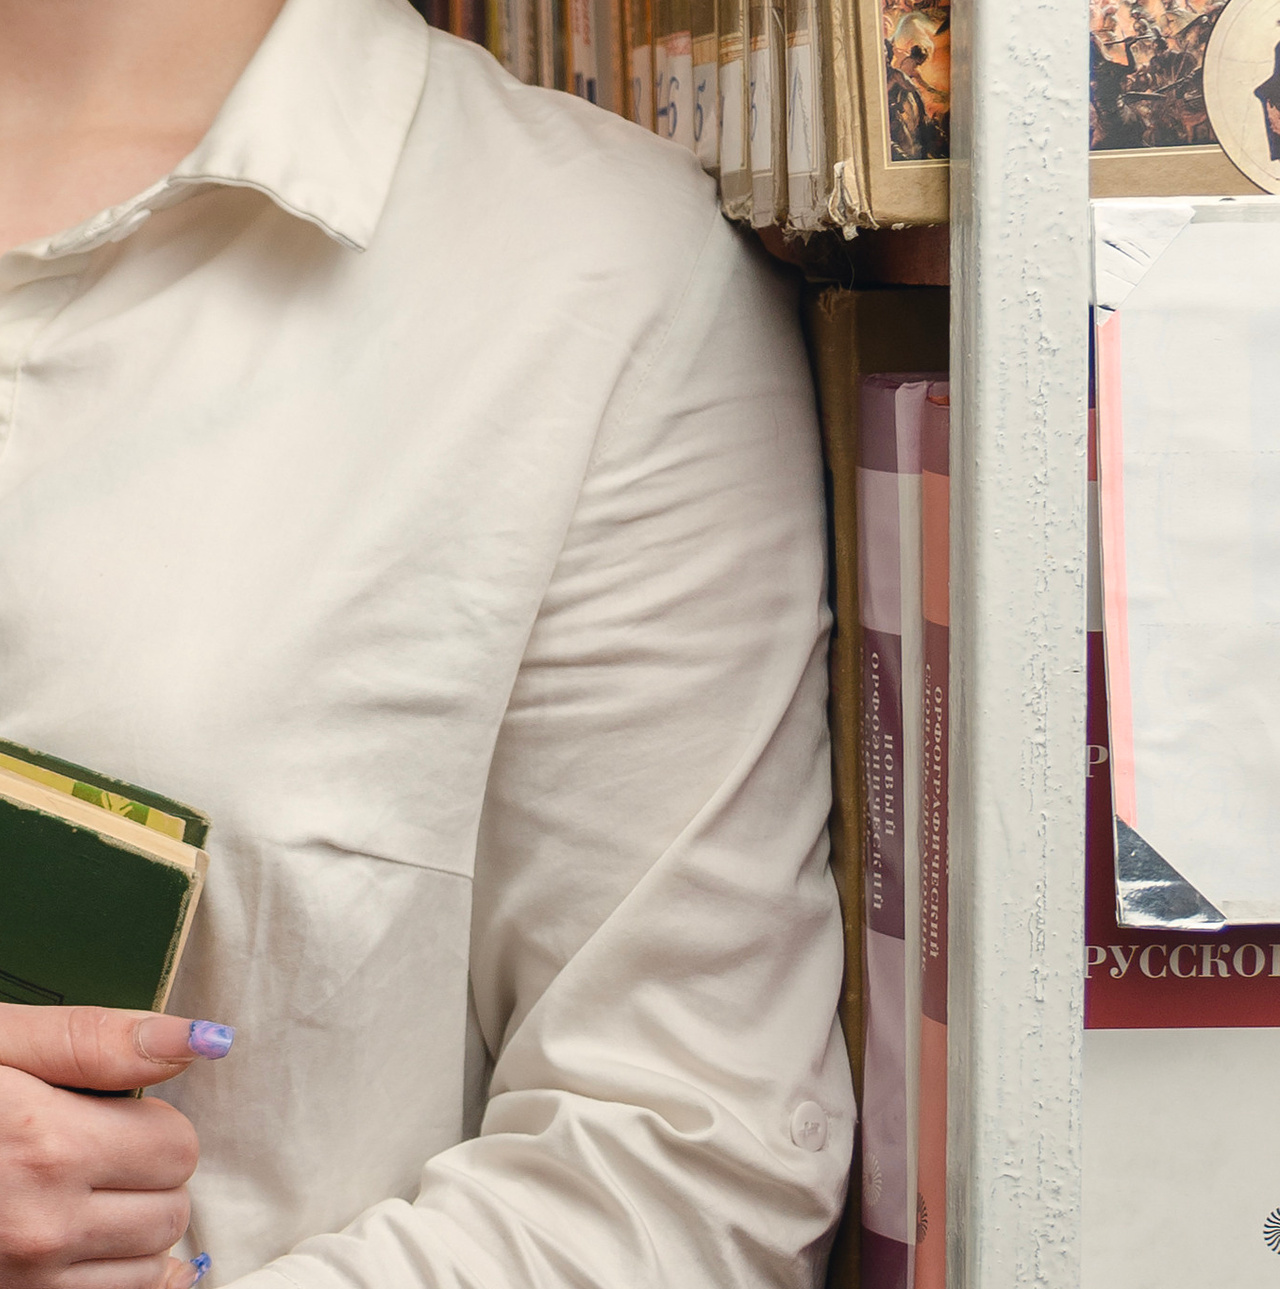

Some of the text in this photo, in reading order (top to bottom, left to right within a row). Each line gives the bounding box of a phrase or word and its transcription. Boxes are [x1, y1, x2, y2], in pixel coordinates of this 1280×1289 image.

[871, 651, 884, 910] ОРФОЭПИЧЕСКИЙ
[883, 733, 896, 837] НОВЫЙ
[929, 686, 944, 959] ОРФОГРАФИЧЕСКИЙ
